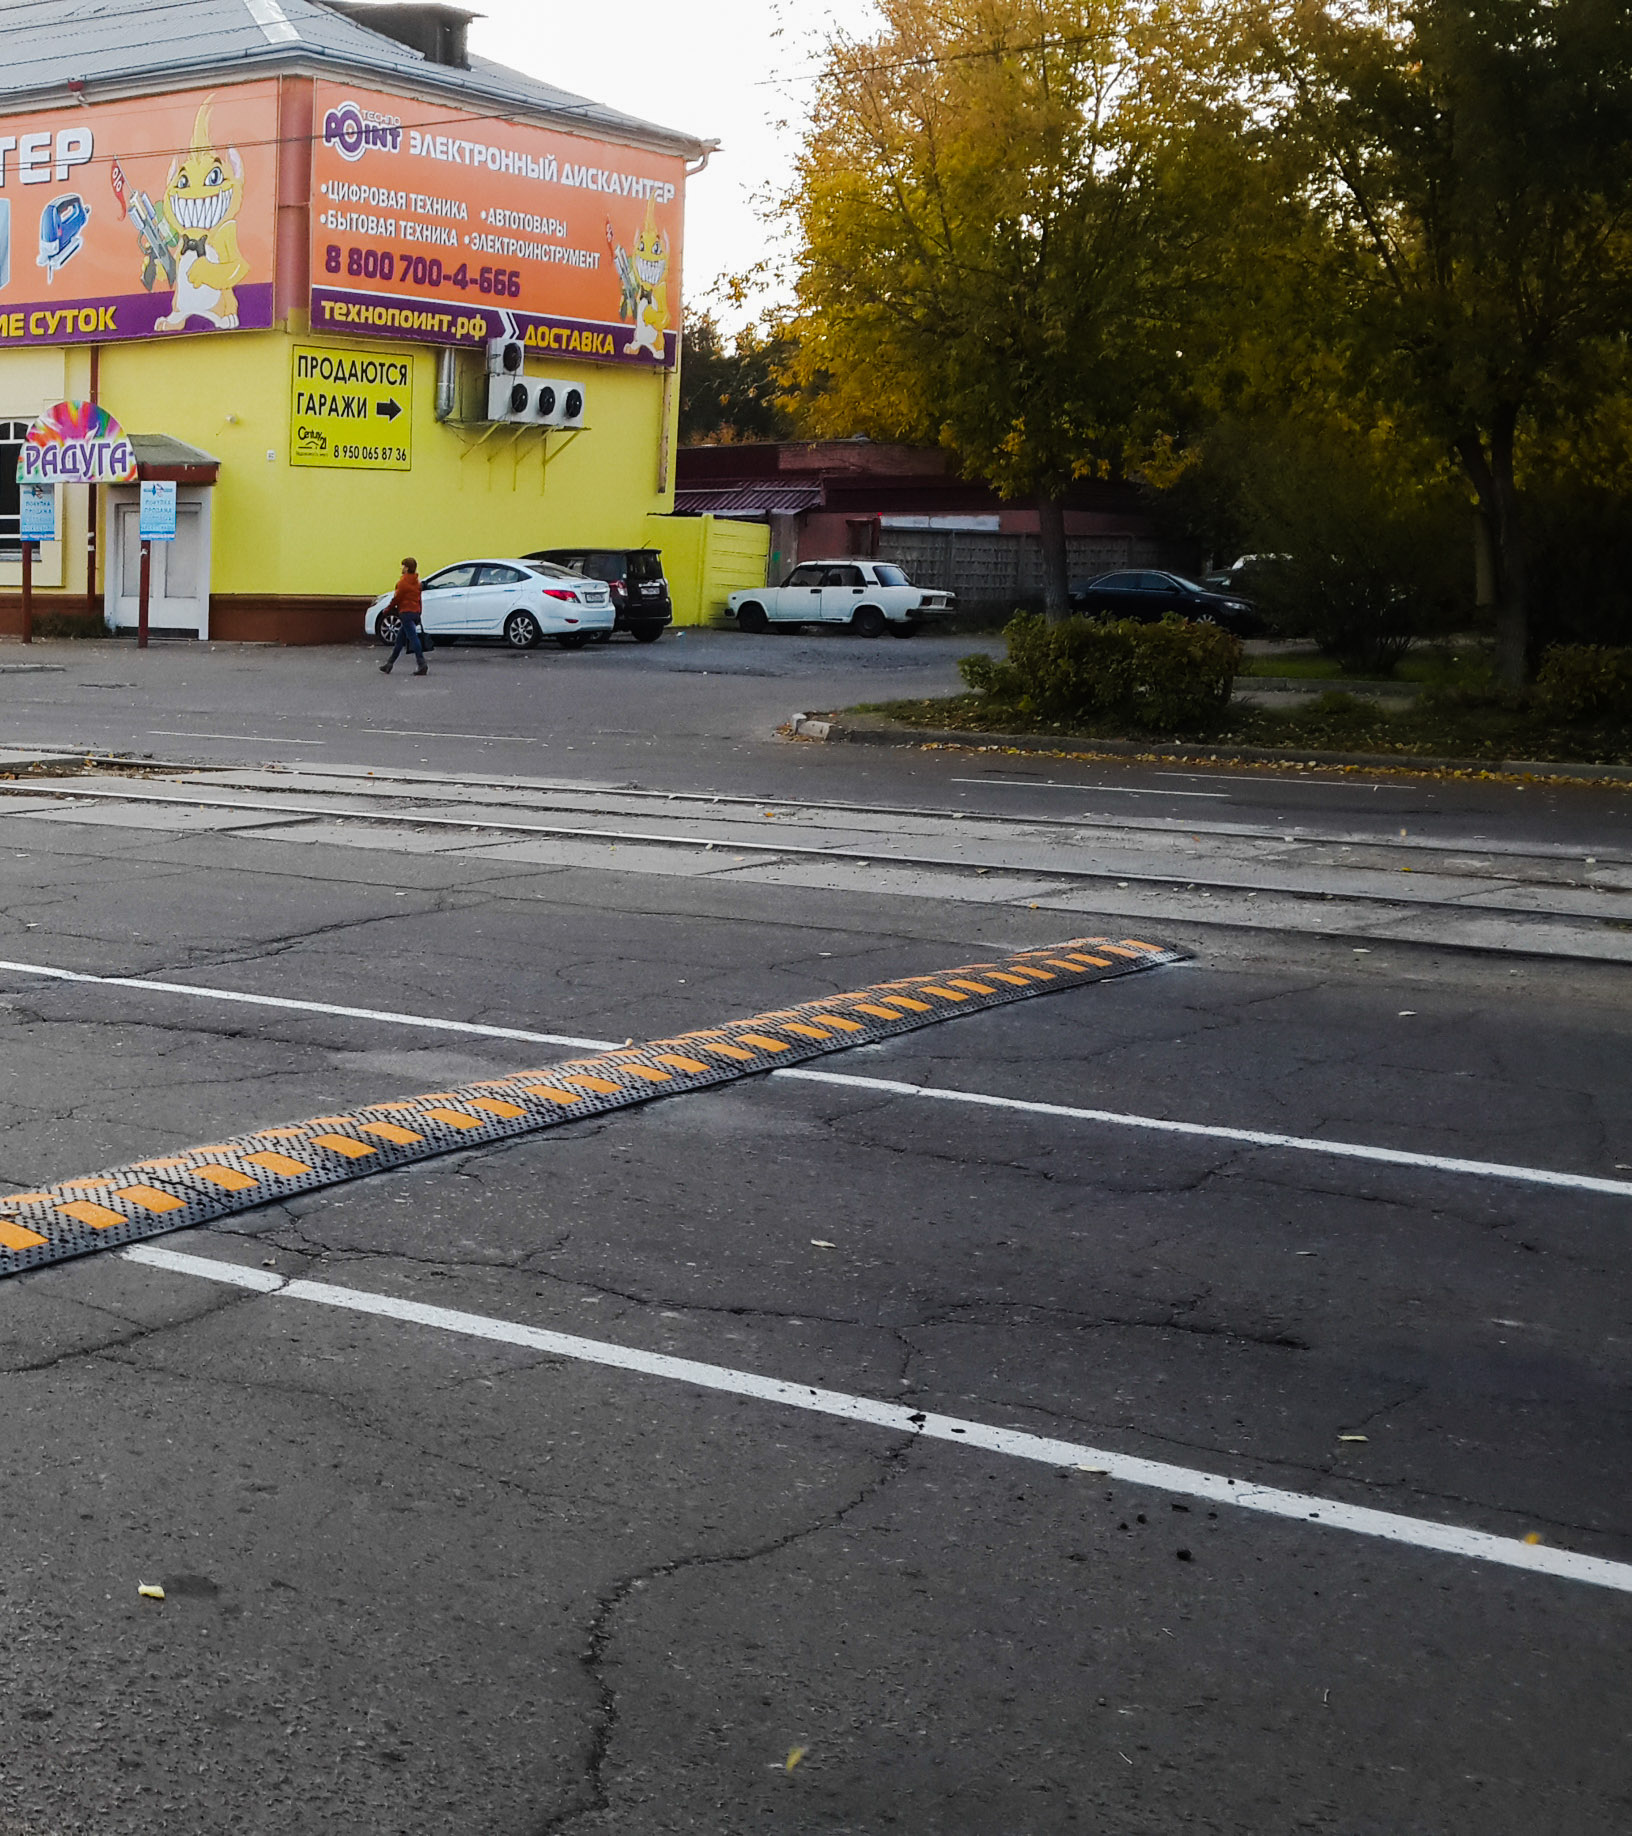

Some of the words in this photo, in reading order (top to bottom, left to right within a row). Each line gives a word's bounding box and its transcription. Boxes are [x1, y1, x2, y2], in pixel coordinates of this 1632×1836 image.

[324, 107, 402, 154] POINT
[361, 110, 401, 126] TECHNO
[409, 131, 558, 183] ЭЛЕКТРОННЫЙ
[560, 163, 675, 205] ДИСКАУНТЕР
[327, 180, 407, 211] ЦИФРОВАЯ
[409, 192, 469, 221] ТЕХНИКА
[326, 209, 397, 239] БЫТОВАЯ
[398, 219, 458, 248] ТЕХНИКА
[487, 207, 568, 238] АВТОТОВАРЫ
[470, 232, 601, 270] ЭЛЕКТРОИНСТРУМЕНТ
[324, 244, 342, 274] 8
[347, 247, 395, 281] 800
[399, 253, 521, 298] 700-4-666
[29, 304, 117, 336] СУТОК
[320, 300, 487, 341] технопоинт.рф
[524, 324, 616, 355] ДОСТАВКА
[297, 354, 408, 387] ПРОДАЮТСЯ
[296, 391, 367, 420] ГАРАЖИ
[297, 426, 322, 441] Century
[24, 441, 129, 478] РАДУГА
[333, 444, 340, 459] 8
[342, 445, 360, 460] 950
[362, 446, 379, 460] 065
[381, 447, 393, 461] 87
[395, 448, 407, 462] 36
